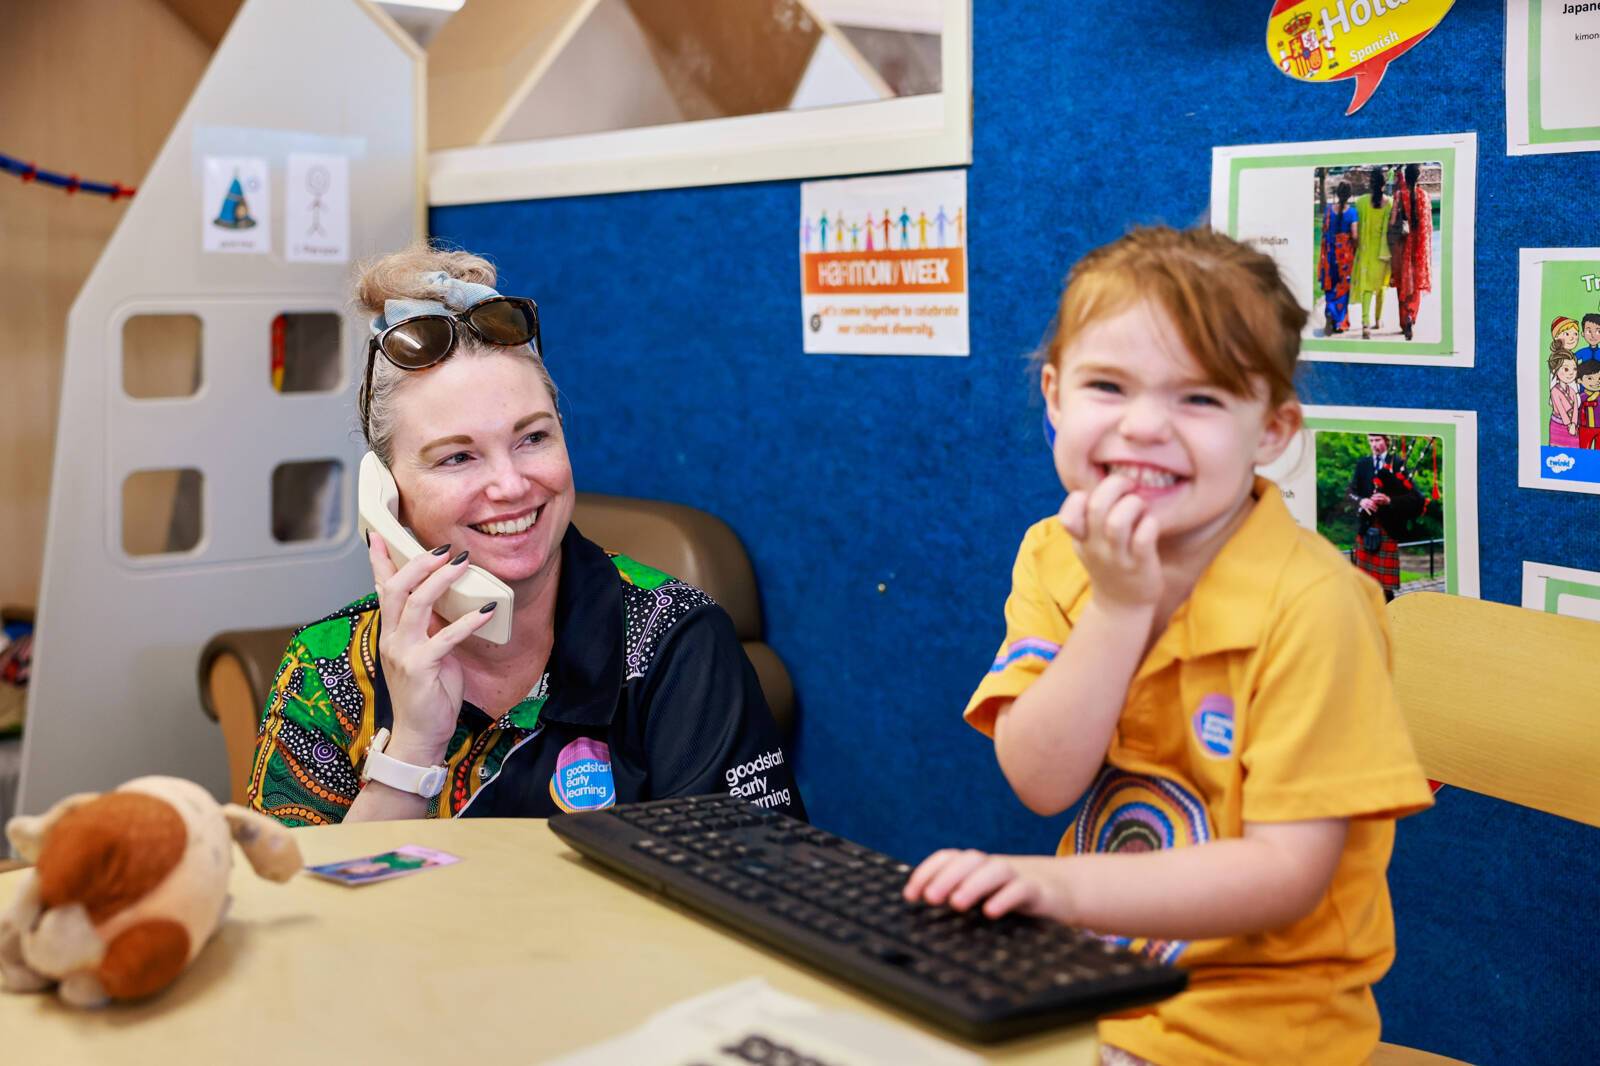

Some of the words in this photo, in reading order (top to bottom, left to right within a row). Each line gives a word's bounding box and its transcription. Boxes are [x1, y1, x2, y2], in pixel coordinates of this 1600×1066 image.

[1350, 30, 1400, 64] Spanish
[900, 257, 950, 285] WEEK
[726, 746, 785, 788] goodstart
[566, 774, 590, 788] early
[566, 784, 607, 799] learning
[729, 775, 768, 798] early
